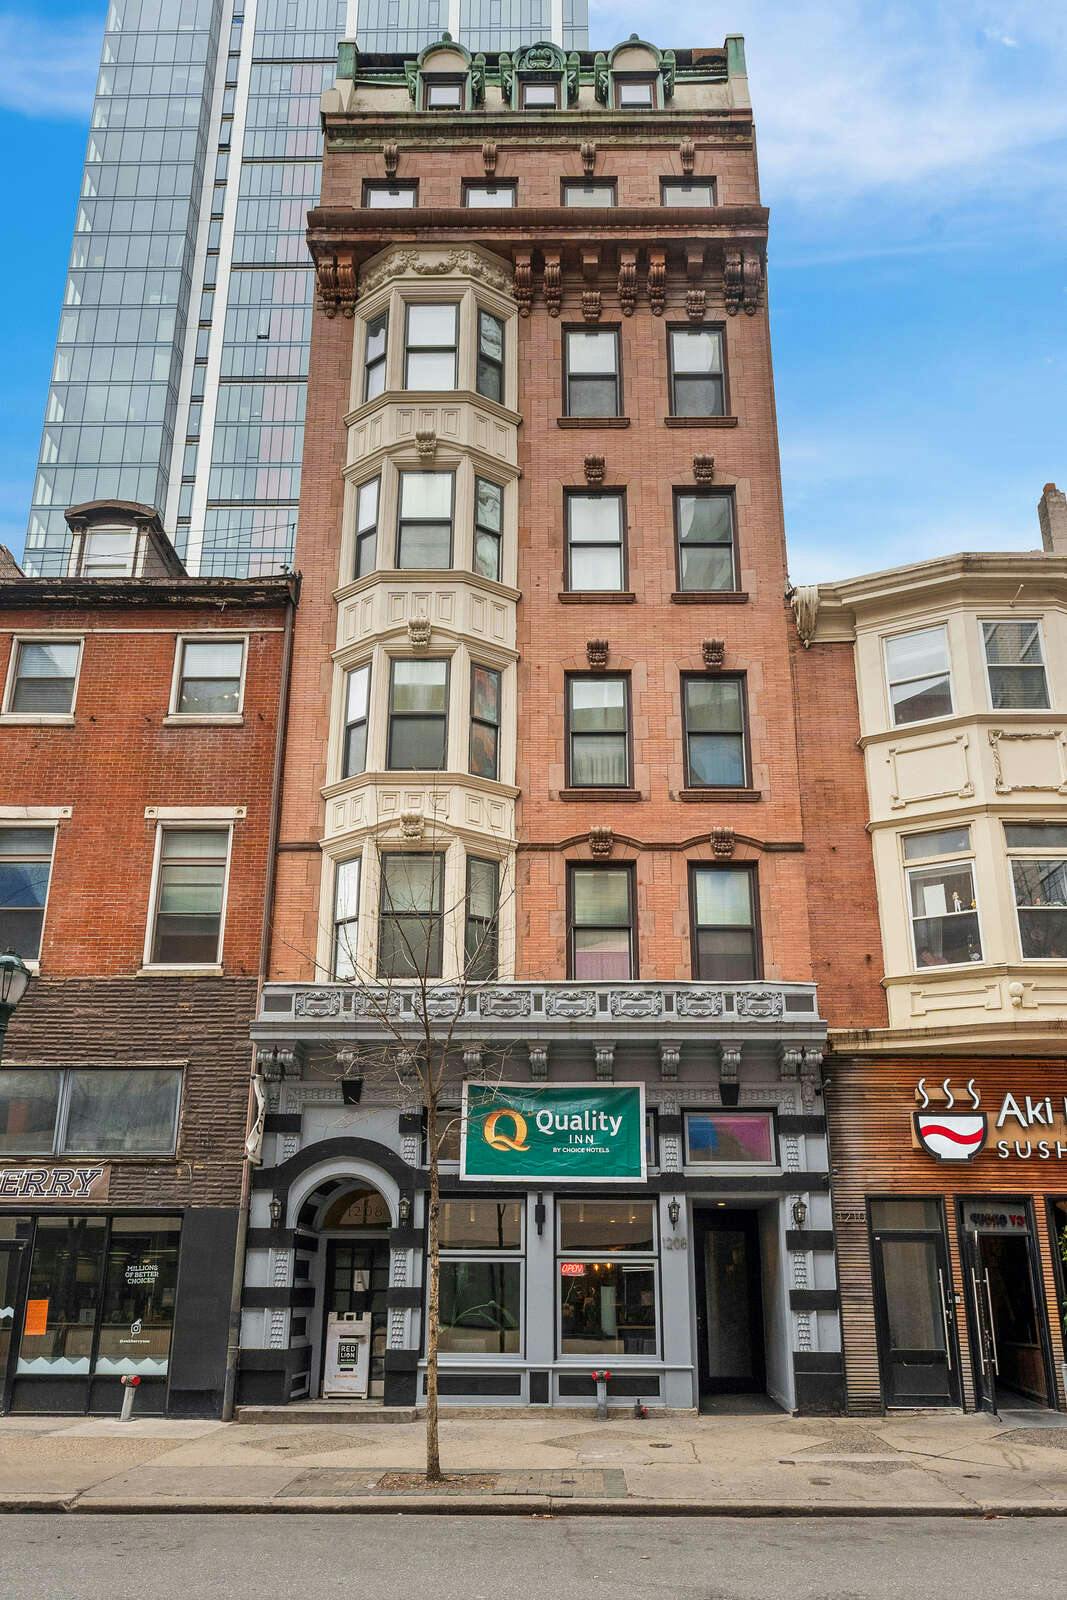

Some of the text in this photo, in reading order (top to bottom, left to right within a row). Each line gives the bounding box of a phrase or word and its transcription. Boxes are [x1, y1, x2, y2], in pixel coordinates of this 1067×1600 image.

[535, 1109, 623, 1136] Quality
[996, 1092, 1054, 1126] Aki
[483, 1108, 531, 1152] Q
[569, 1134, 594, 1144] INN
[561, 1263, 584, 1274] OPEN
